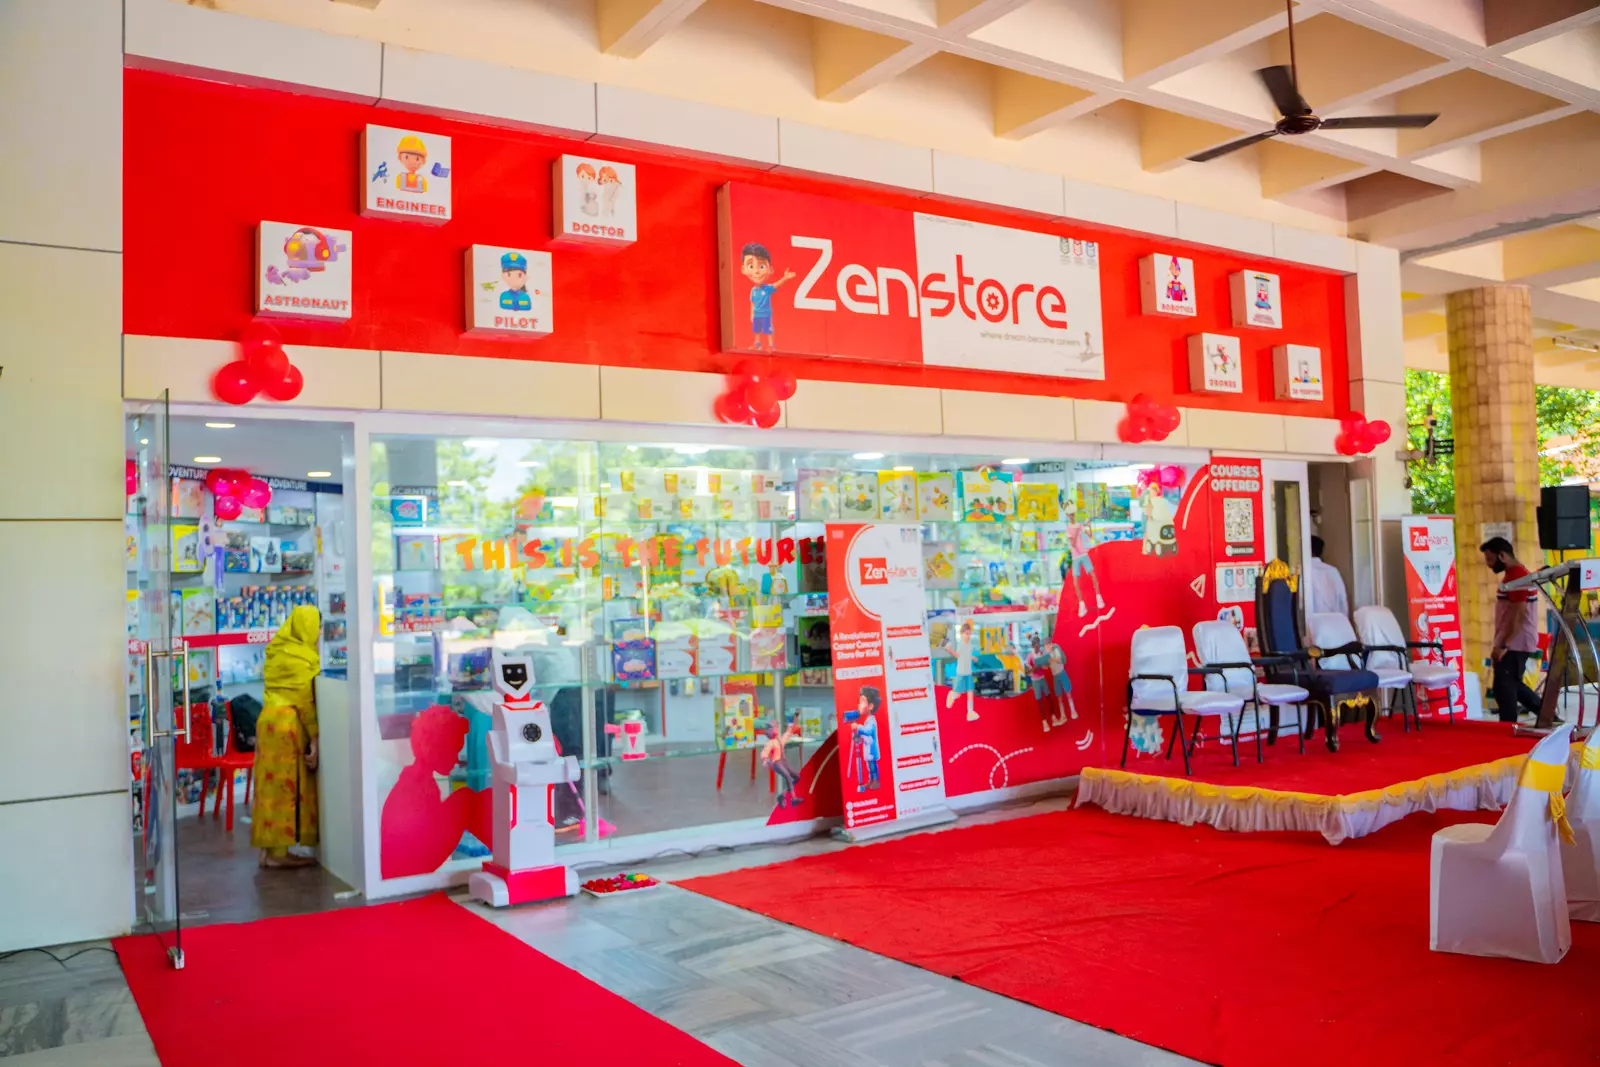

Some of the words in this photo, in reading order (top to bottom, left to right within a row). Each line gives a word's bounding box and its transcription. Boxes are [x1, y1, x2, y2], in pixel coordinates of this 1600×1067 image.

[376, 197, 446, 216] ENGINEER
[571, 221, 625, 238] DOCTOR
[790, 235, 1069, 330] Zenstore
[264, 294, 349, 311] ASTRONAUT
[494, 315, 538, 330] PILOT
[1210, 464, 1260, 478] COURSES
[1211, 478, 1260, 493] OFFERED
[455, 537, 547, 571] THIS
[561, 537, 601, 569] IS
[615, 537, 685, 568] THE
[696, 535, 825, 568] FUTURE!
